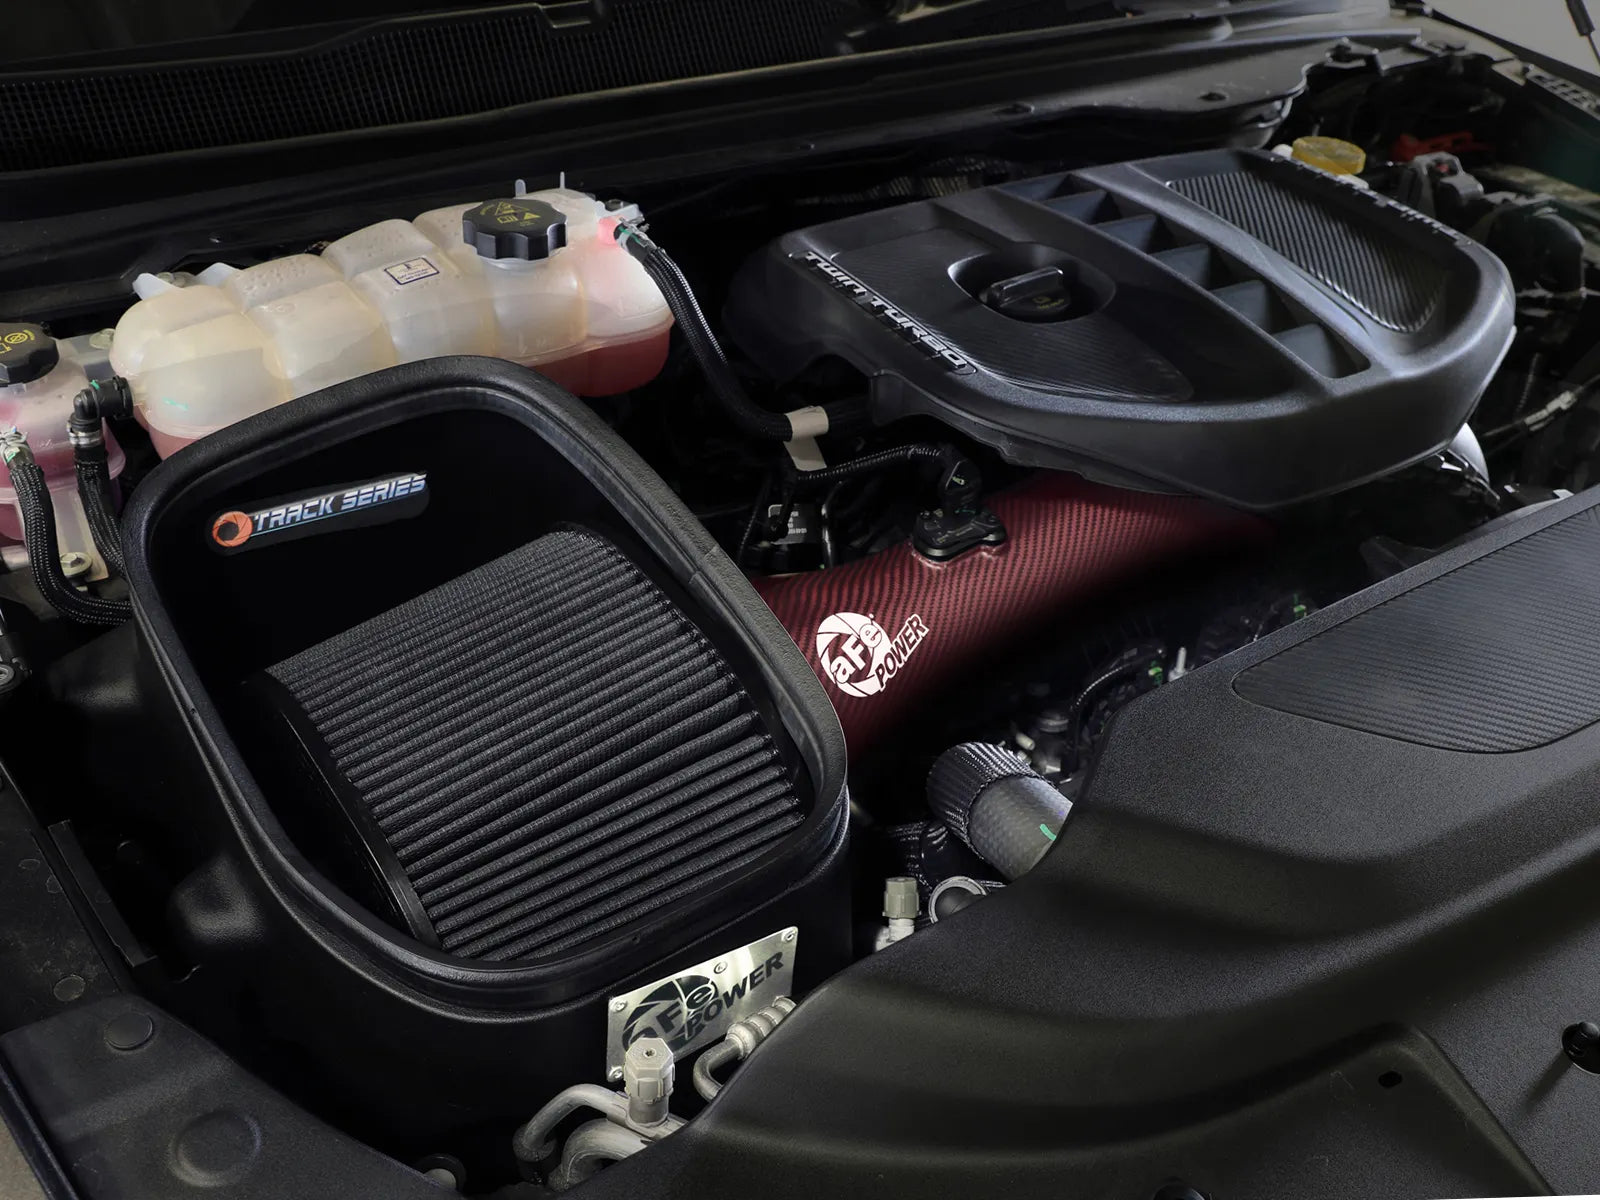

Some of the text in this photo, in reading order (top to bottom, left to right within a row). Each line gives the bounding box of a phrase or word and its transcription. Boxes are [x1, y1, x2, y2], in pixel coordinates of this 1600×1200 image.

[805, 251, 968, 369] TWIN TURBO
[254, 473, 427, 531] TRACK SERIES
[875, 614, 928, 690] POWER
[687, 951, 784, 1038] POWER
